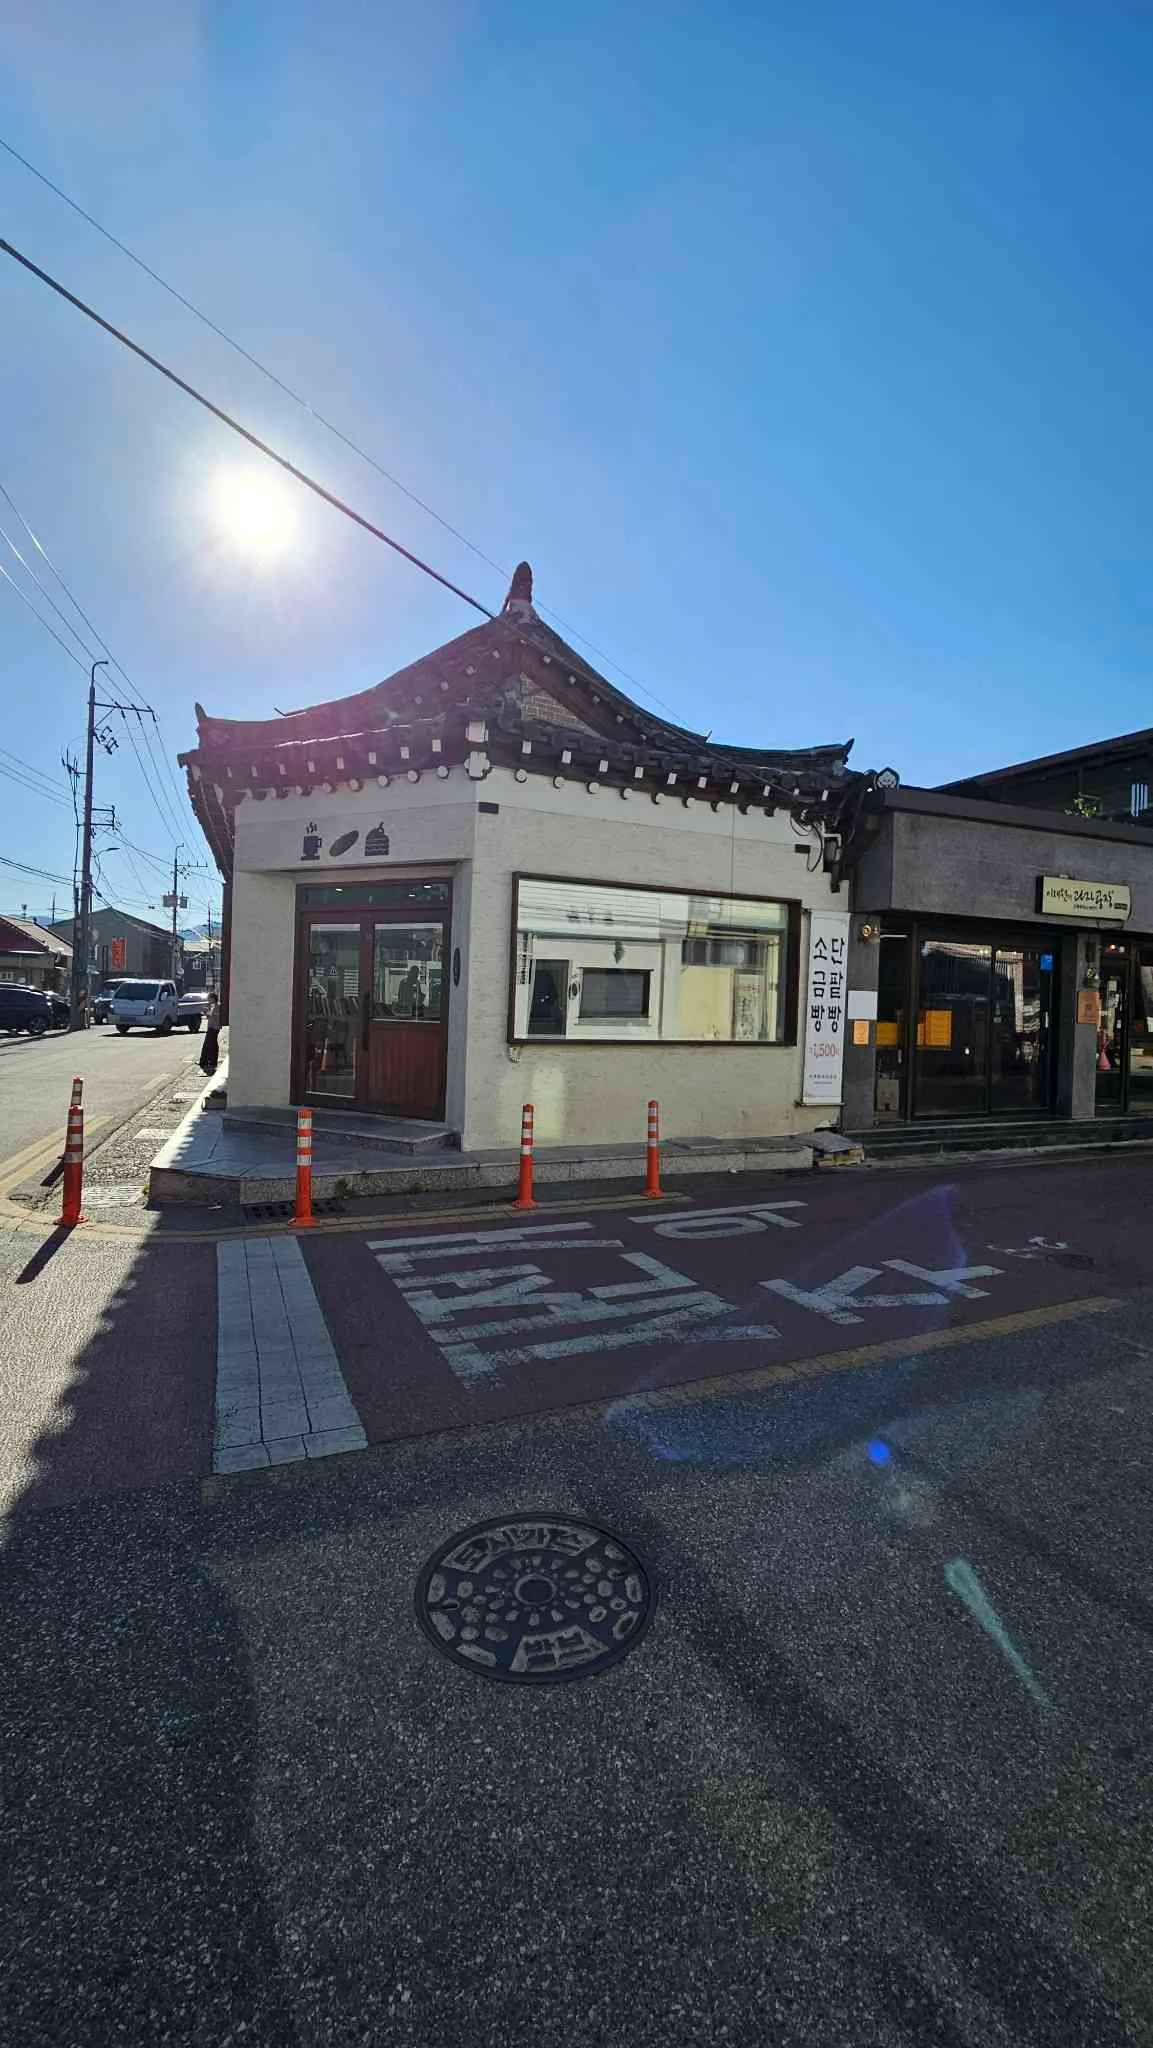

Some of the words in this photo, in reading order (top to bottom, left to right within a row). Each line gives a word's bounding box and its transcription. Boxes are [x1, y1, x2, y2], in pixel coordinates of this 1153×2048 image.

[811, 937, 828, 1033] 소금빵
[829, 937, 845, 1033] 단팥빵
[366, 1222, 782, 1391] 자전거
[628, 1200, 1004, 1324] 주의
